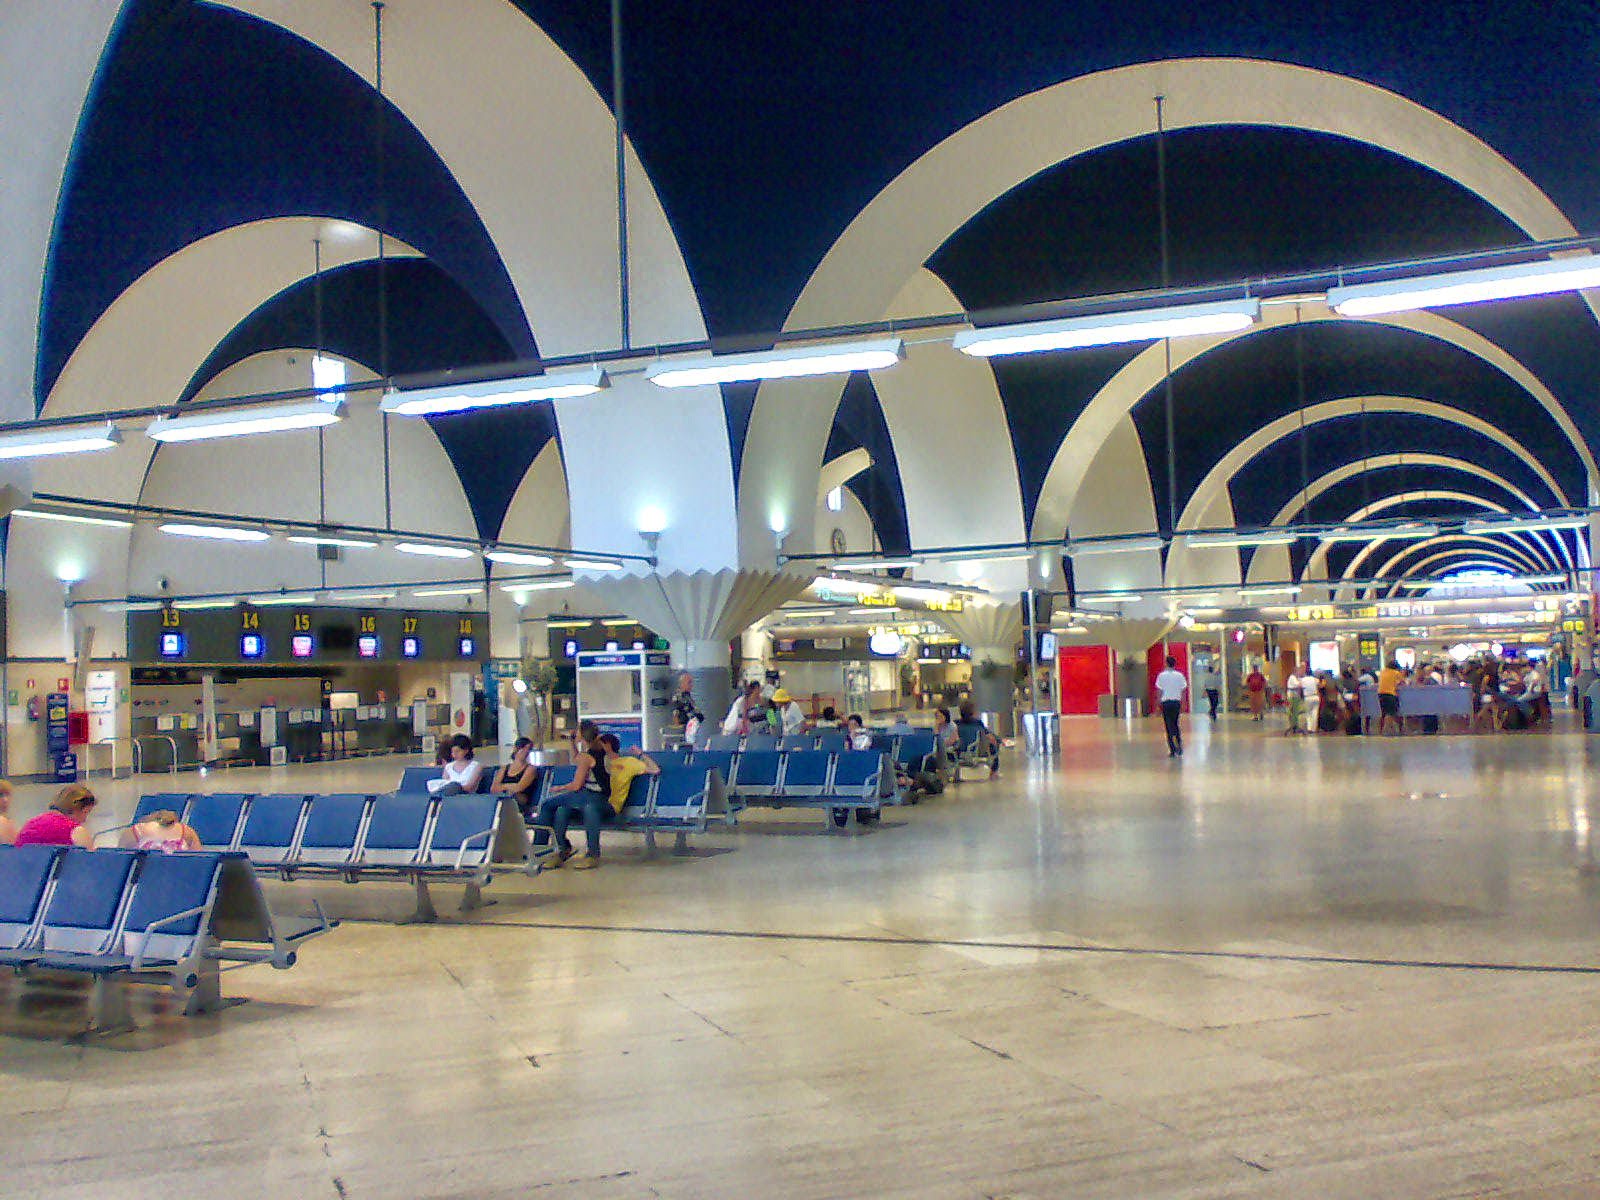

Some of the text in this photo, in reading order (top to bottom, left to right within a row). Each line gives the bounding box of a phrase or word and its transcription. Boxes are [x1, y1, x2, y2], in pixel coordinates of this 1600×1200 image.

[162, 608, 180, 627] 13
[243, 611, 259, 629] 14
[295, 614, 310, 631] 15
[360, 616, 376, 633] 16
[403, 618, 418, 633] 17
